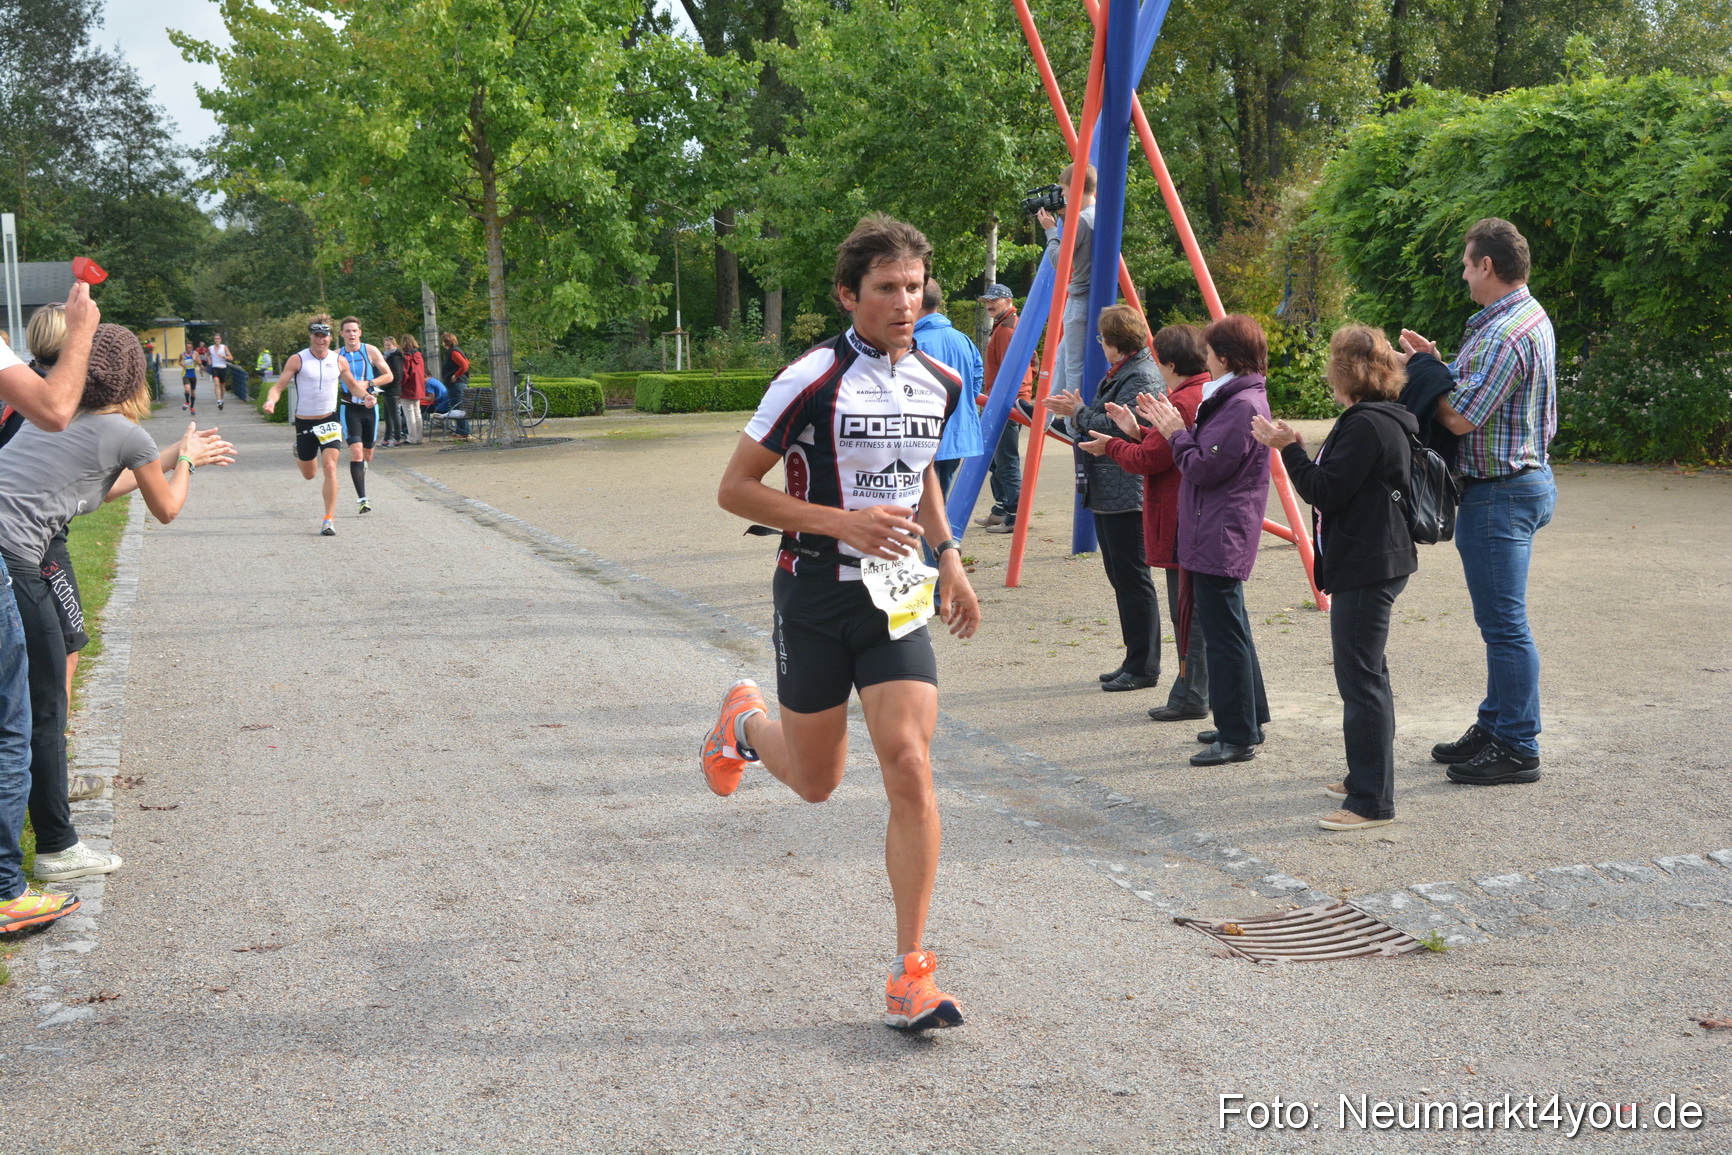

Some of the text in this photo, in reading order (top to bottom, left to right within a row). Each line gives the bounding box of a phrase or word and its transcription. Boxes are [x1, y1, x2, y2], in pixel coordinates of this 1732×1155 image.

[320, 423, 338, 434] 345
[839, 440, 853, 448] DIE
[779, 629, 788, 675] odlo
